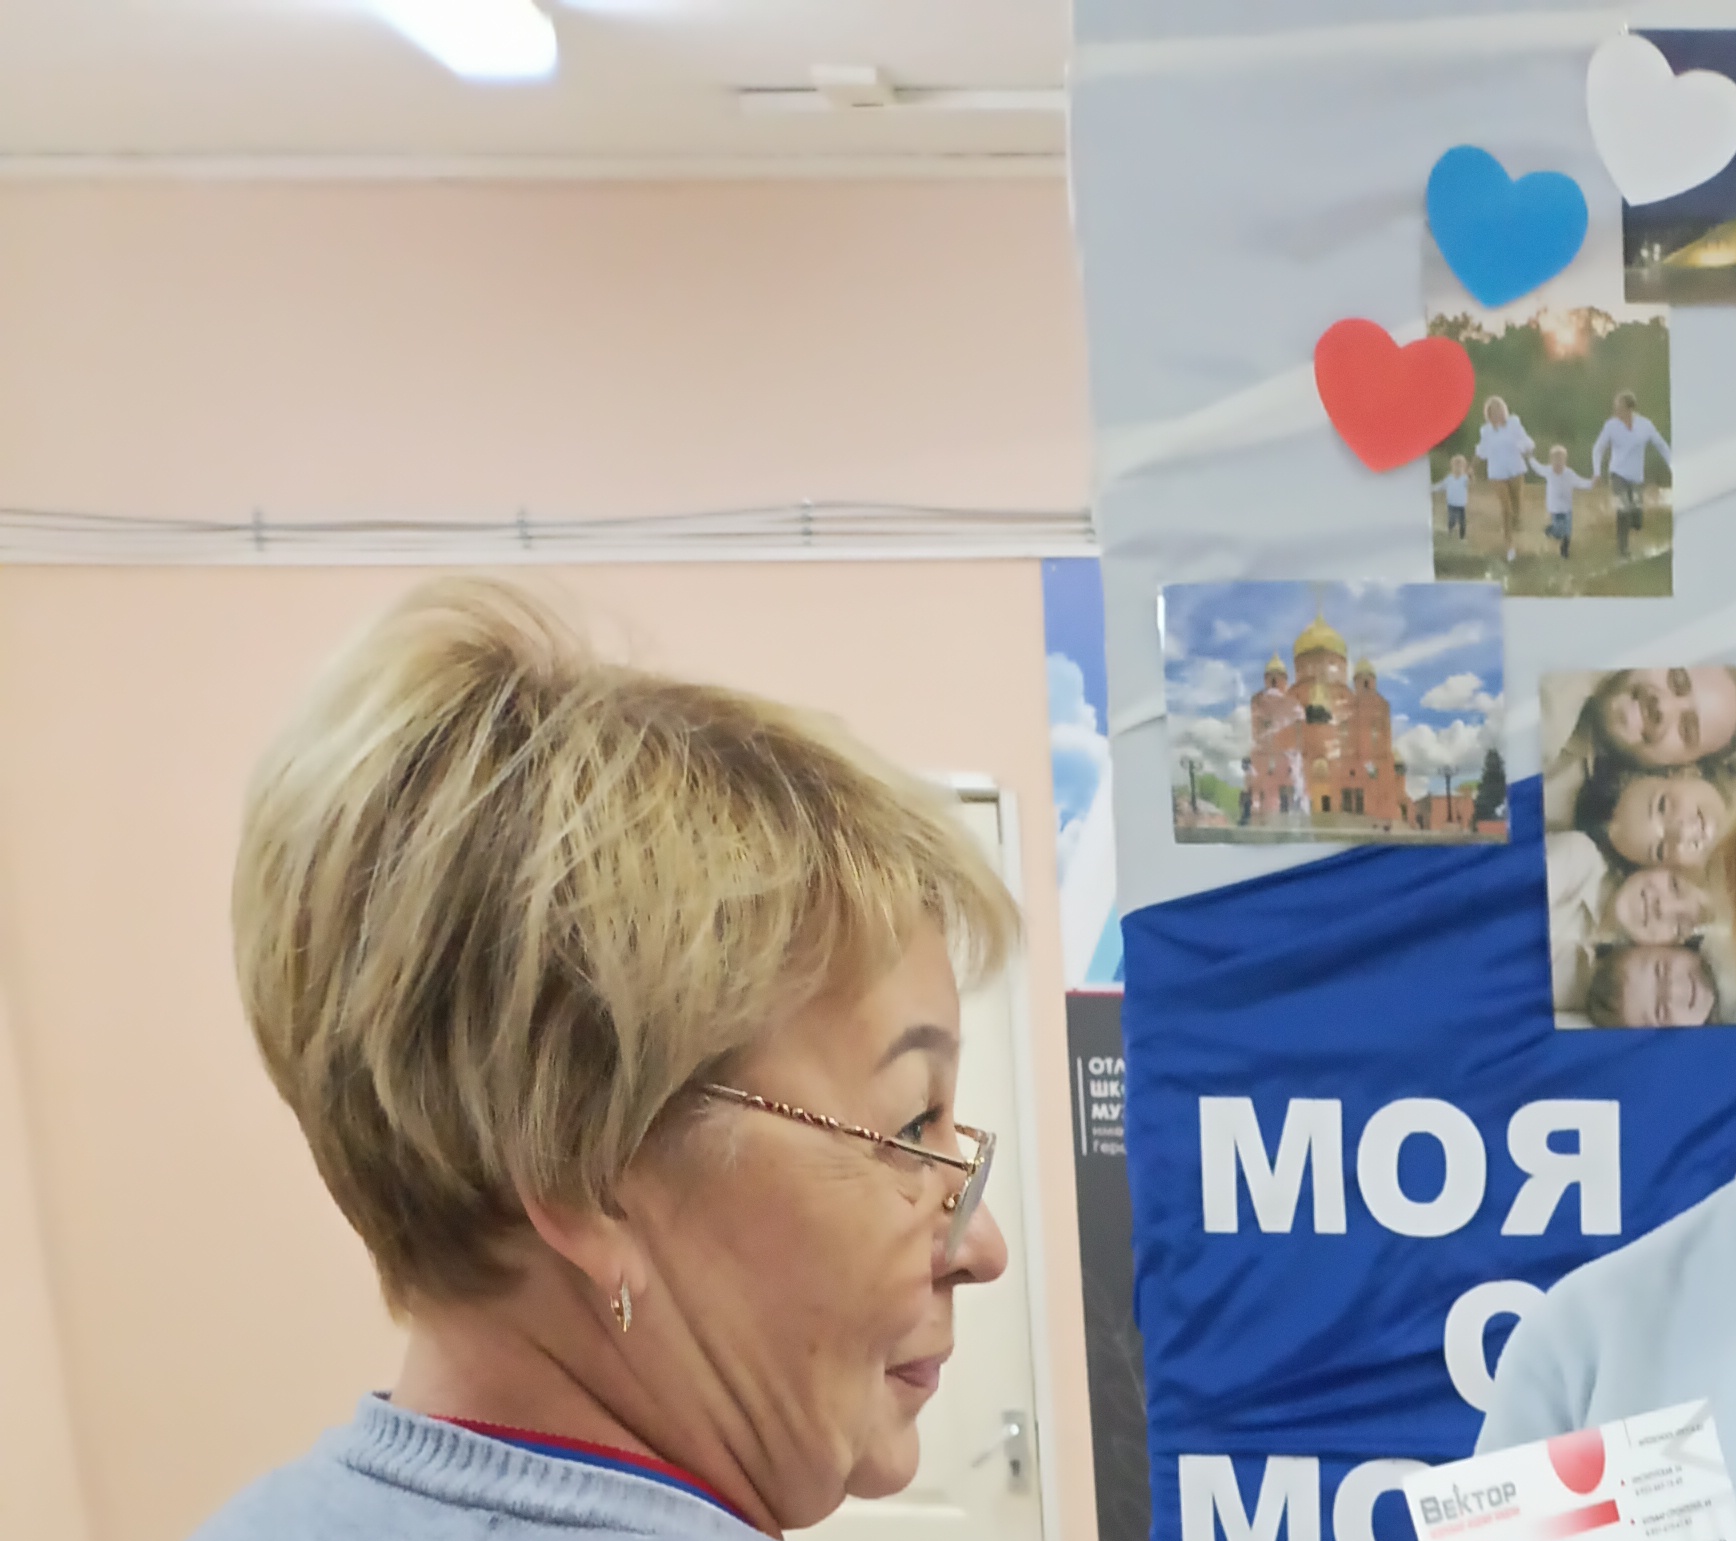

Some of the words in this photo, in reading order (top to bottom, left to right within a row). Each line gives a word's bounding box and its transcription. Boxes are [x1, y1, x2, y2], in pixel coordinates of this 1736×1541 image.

[1088, 1056, 1125, 1075] ОТЛ
[1091, 1103, 1124, 1120] МУ
[1198, 1095, 1622, 1237] МОЯ
